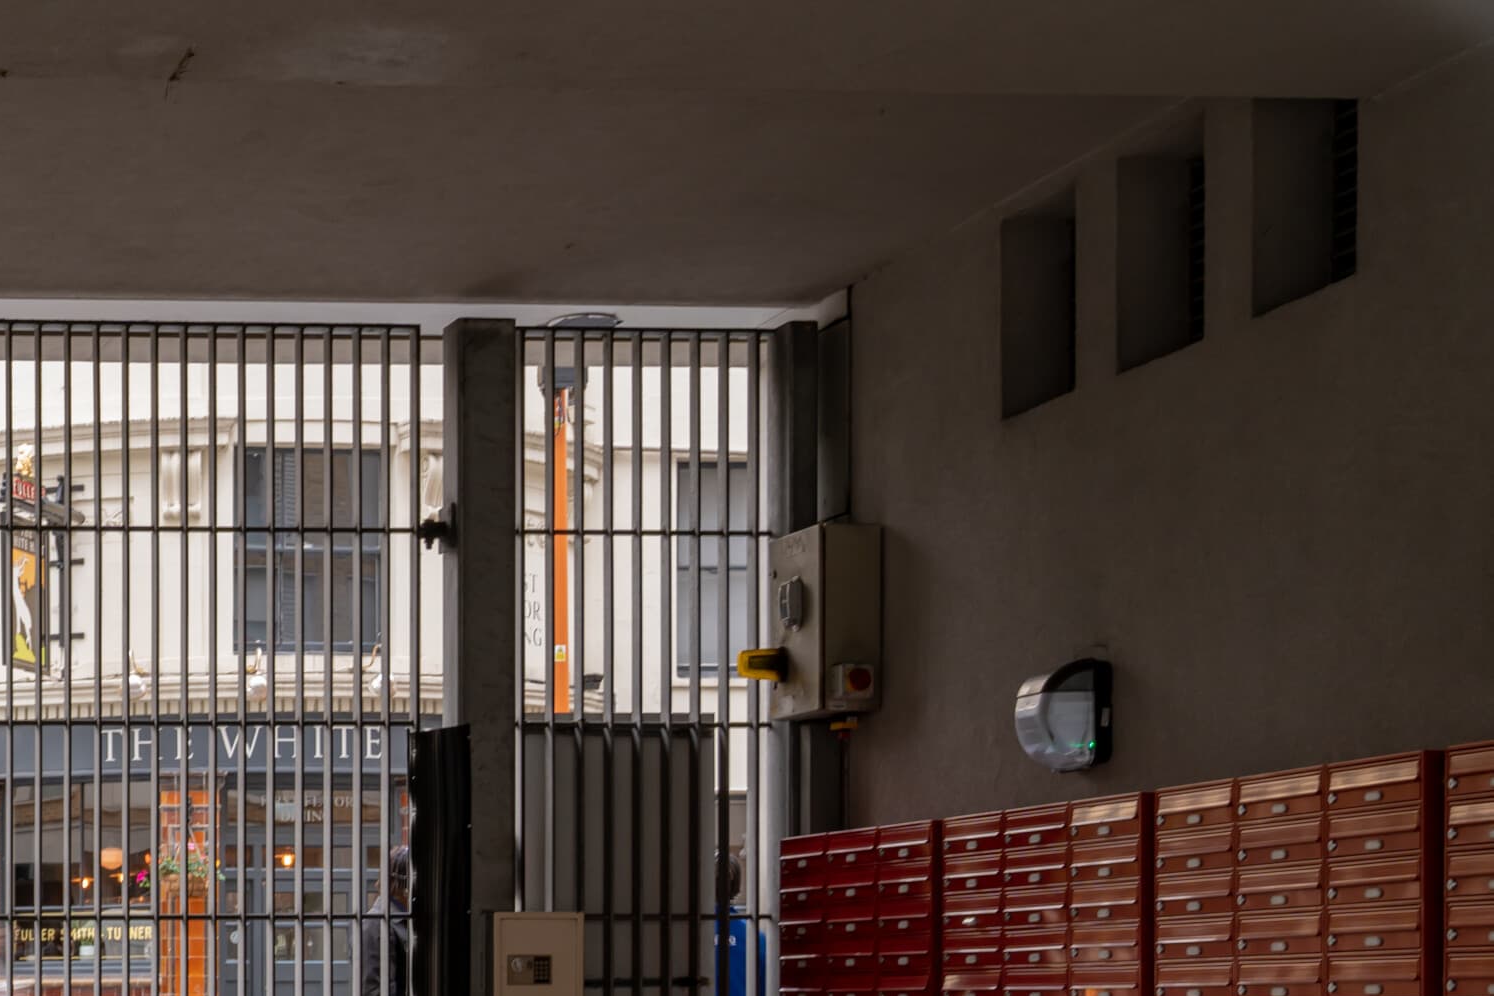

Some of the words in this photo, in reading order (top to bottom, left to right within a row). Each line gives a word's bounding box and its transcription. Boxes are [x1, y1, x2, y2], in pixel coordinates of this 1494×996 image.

[217, 725, 383, 760] WHITE
[14, 927, 56, 942] FULER
[106, 926, 153, 941] TUNER
